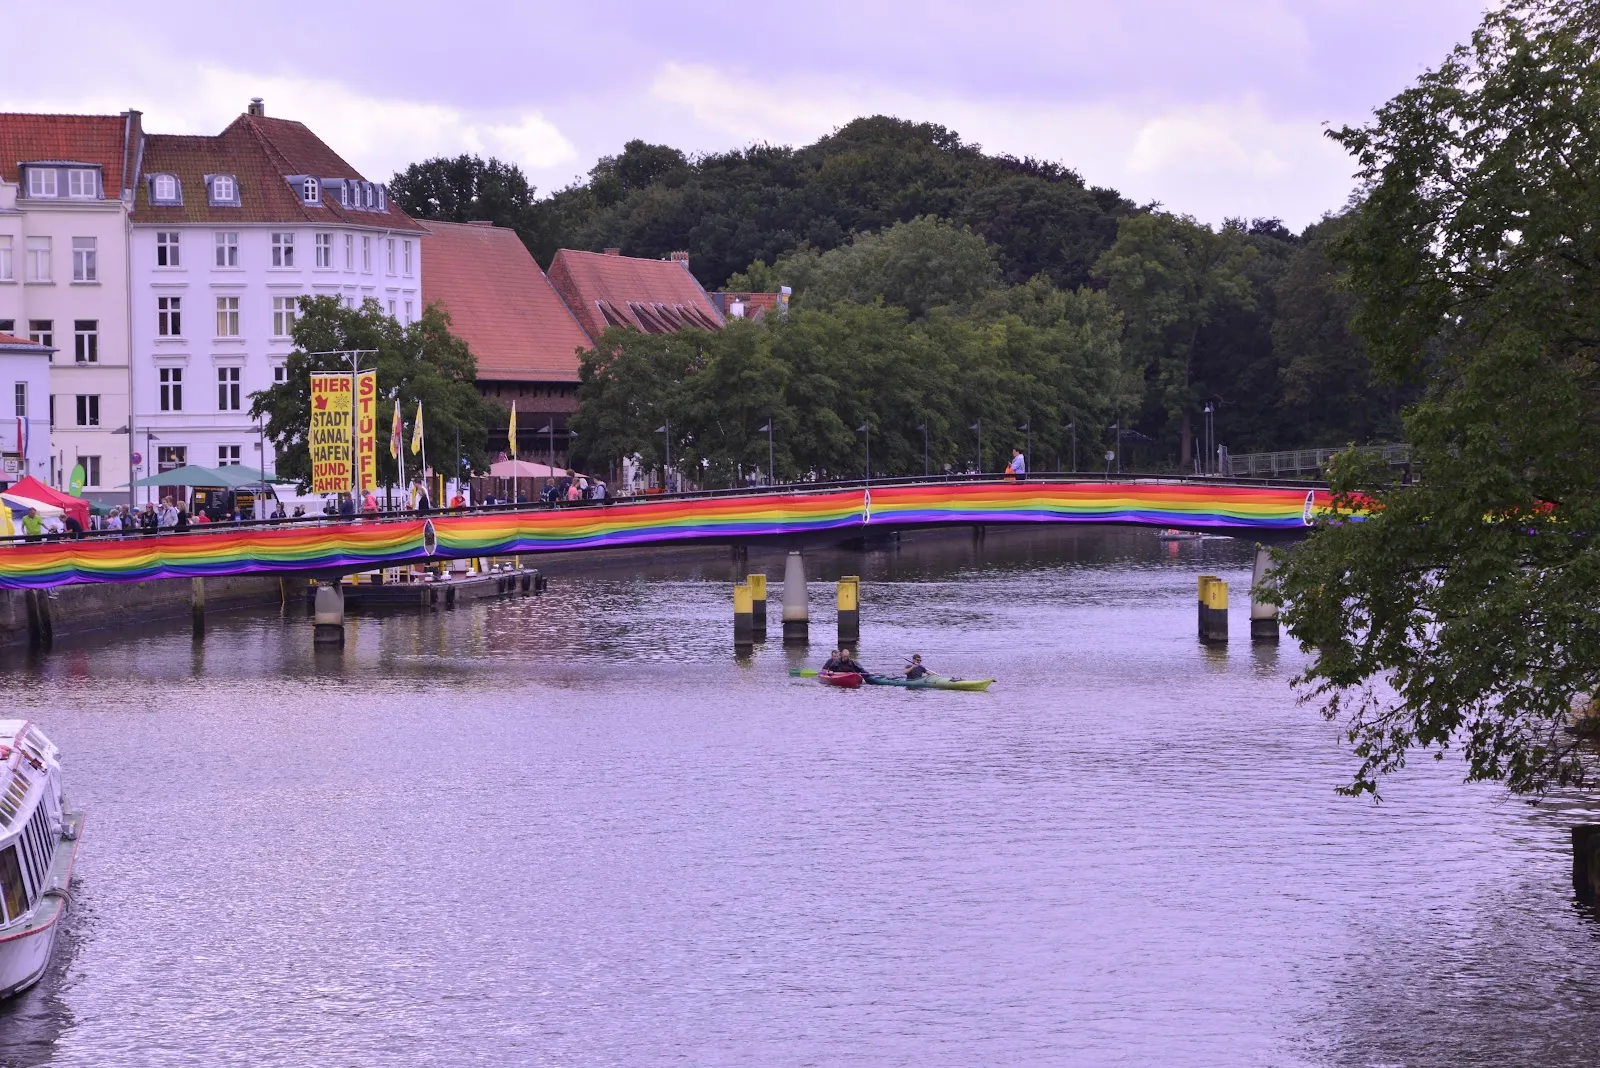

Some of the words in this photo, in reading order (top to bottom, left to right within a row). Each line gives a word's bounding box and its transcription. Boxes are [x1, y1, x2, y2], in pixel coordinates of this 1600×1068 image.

[312, 378, 350, 393] HIER
[313, 411, 349, 427] STADT
[313, 428, 349, 445] KANAL
[359, 376, 374, 490] STÜHFF
[313, 445, 349, 462] HAFEN
[314, 462, 349, 478] RUND-
[314, 477, 349, 492] FAHRT
